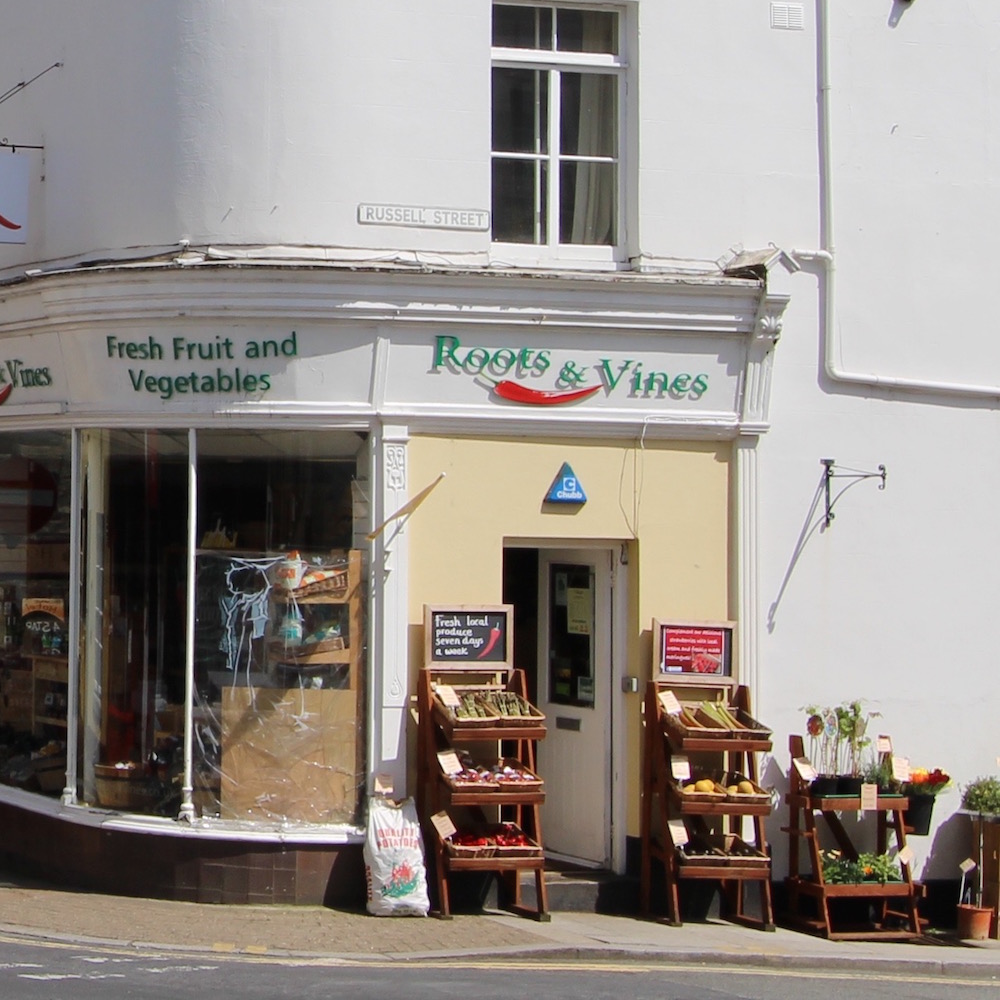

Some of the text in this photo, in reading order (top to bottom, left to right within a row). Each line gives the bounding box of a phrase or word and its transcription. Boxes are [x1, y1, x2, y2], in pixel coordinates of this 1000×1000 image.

[366, 207, 484, 226] RUSSELL STREET
[106, 331, 298, 360] Fresh Fruit and
[434, 335, 709, 392] Roots & Vines
[5, 359, 52, 388] Vines
[128, 367, 271, 399] Vegetables
[557, 491, 582, 499] Chubb
[435, 614, 488, 627] Fresh local
[435, 627, 472, 638] produce
[435, 636, 484, 648] seven days
[435, 647, 469, 656] a week
